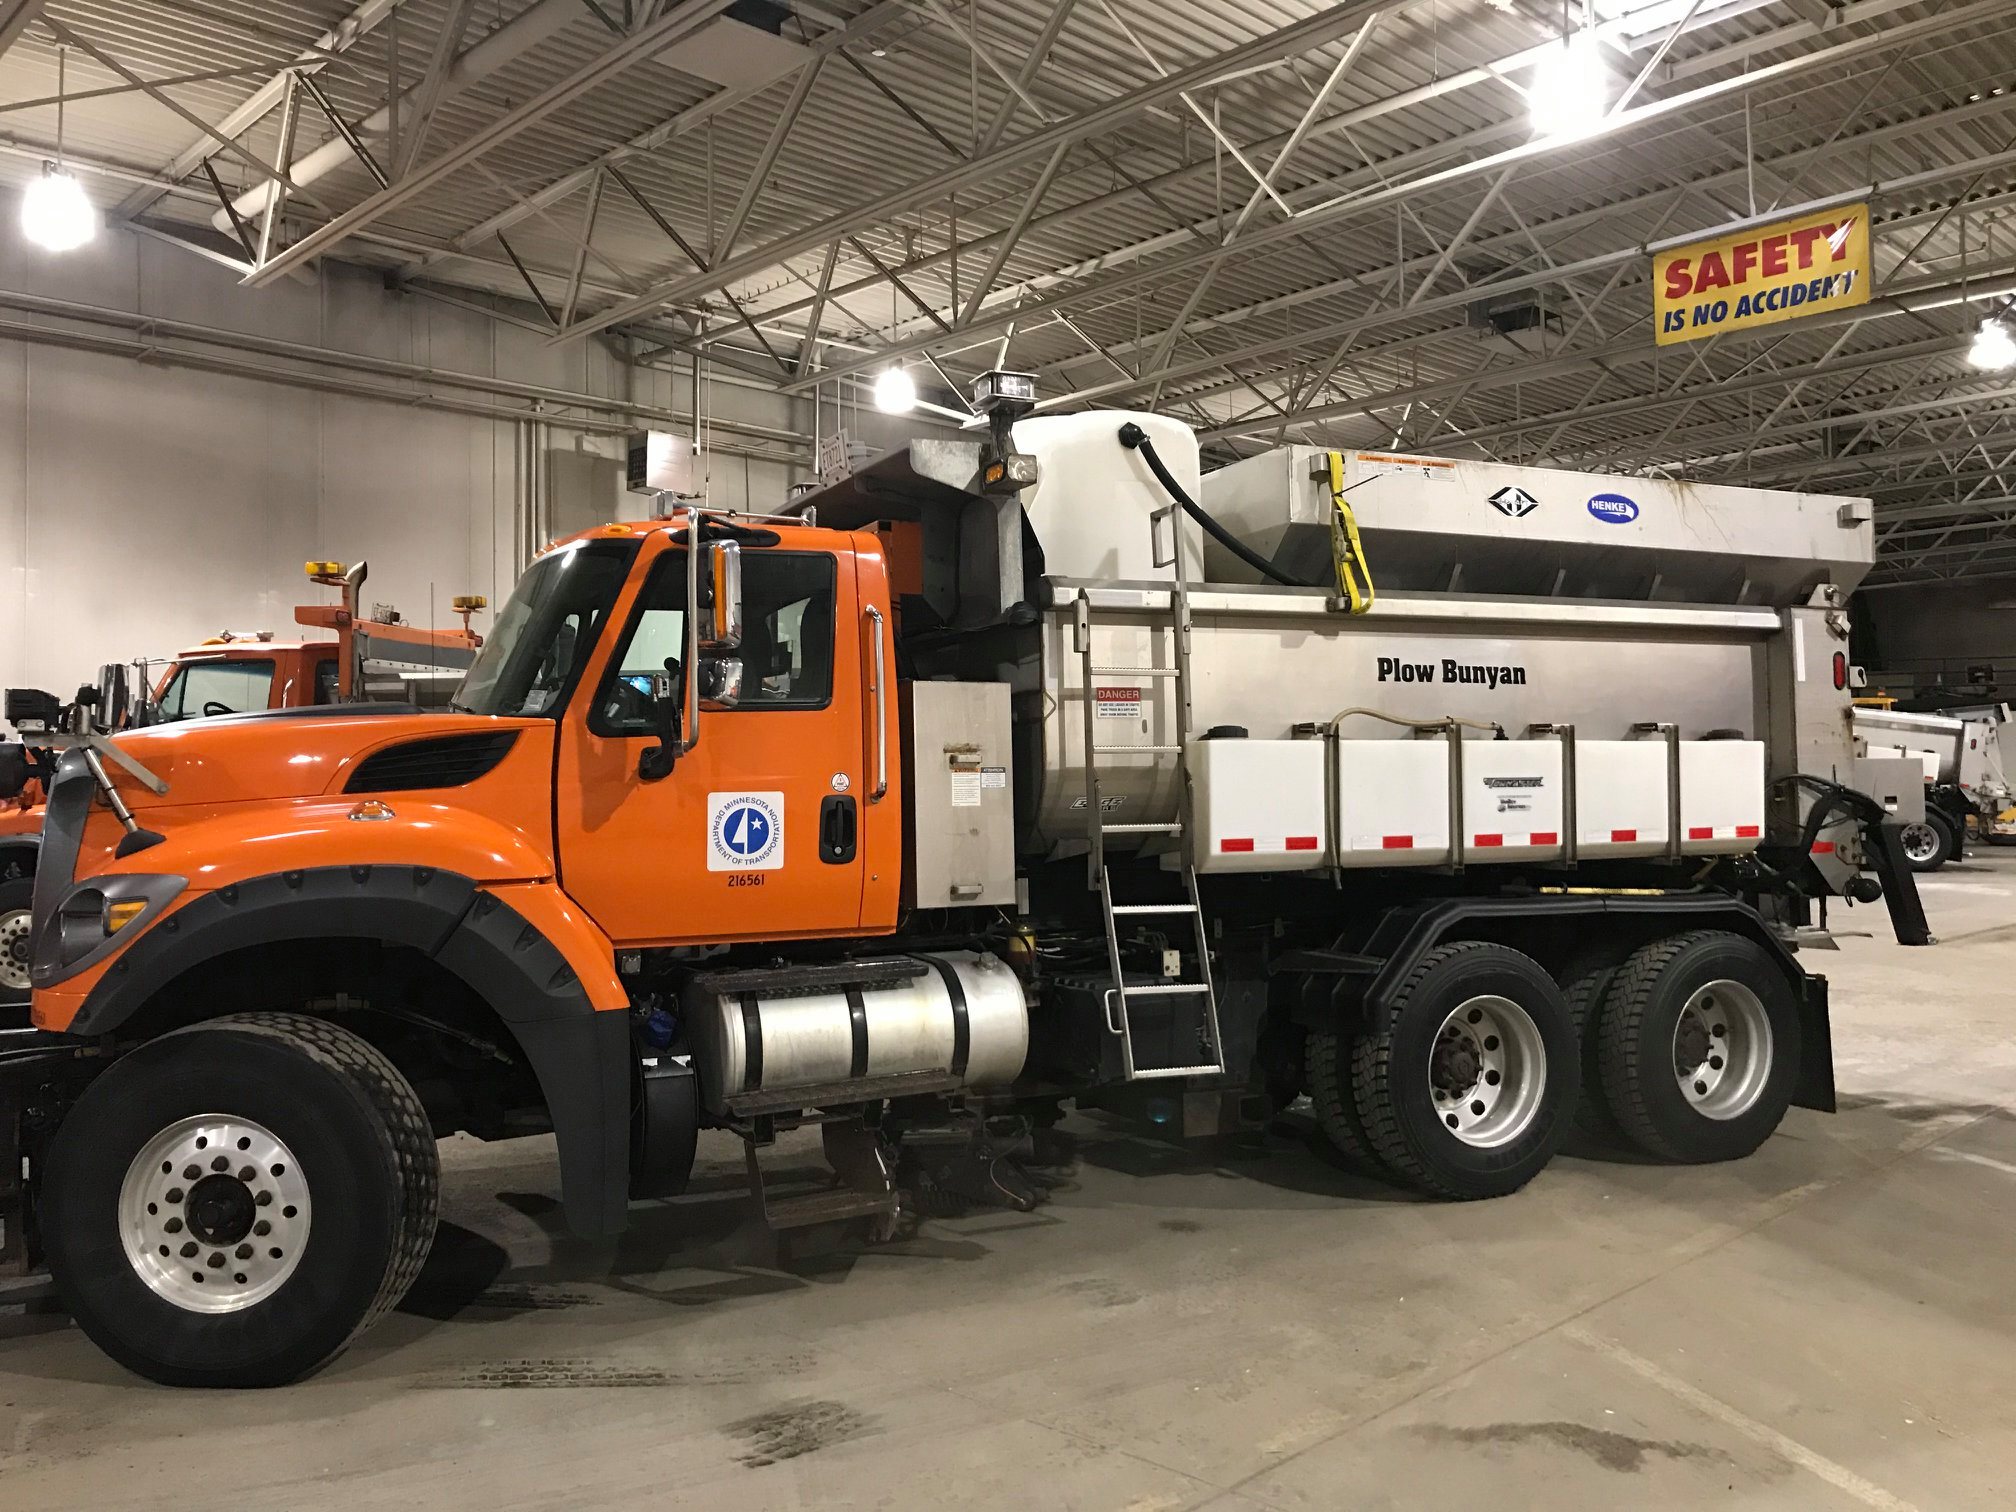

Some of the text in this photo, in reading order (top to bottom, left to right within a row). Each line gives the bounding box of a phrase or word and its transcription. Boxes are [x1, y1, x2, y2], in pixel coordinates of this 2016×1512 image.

[1665, 216, 1858, 299] SAFETY
[1663, 270, 1858, 333] IS NO ACCIDENT
[1591, 500, 1626, 512] HENKE
[1377, 657, 1527, 690] Plow Bunyan
[1098, 690, 1140, 699] DANGER
[724, 797, 769, 811] MINNESOTA
[713, 809, 780, 865] DEPARTMENT OF TRANSPORTATION
[728, 874, 765, 888] 216561
